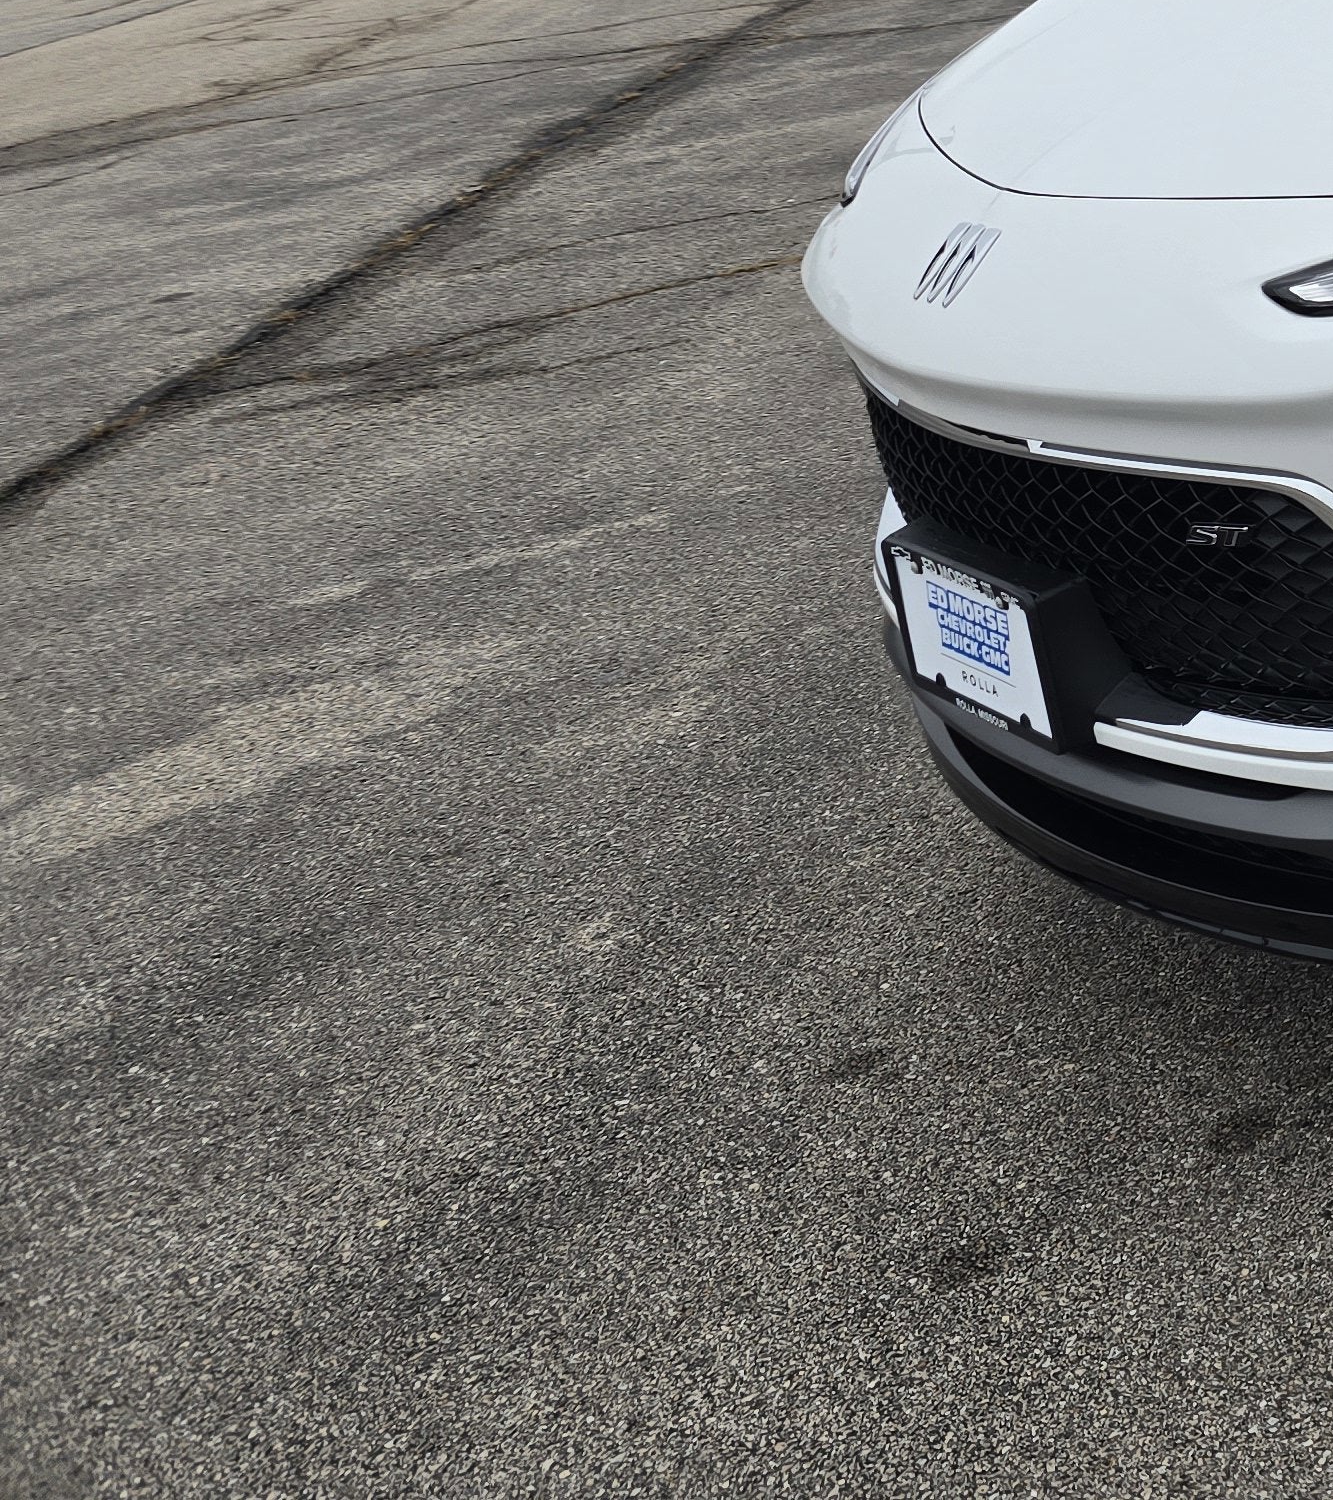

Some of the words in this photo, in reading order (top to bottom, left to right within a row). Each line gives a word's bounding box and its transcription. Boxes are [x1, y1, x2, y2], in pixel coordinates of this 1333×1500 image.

[1186, 525, 1249, 547] ST
[927, 581, 949, 612] ED
[947, 590, 1009, 638] MORSE
[961, 670, 999, 698] ROLLA
